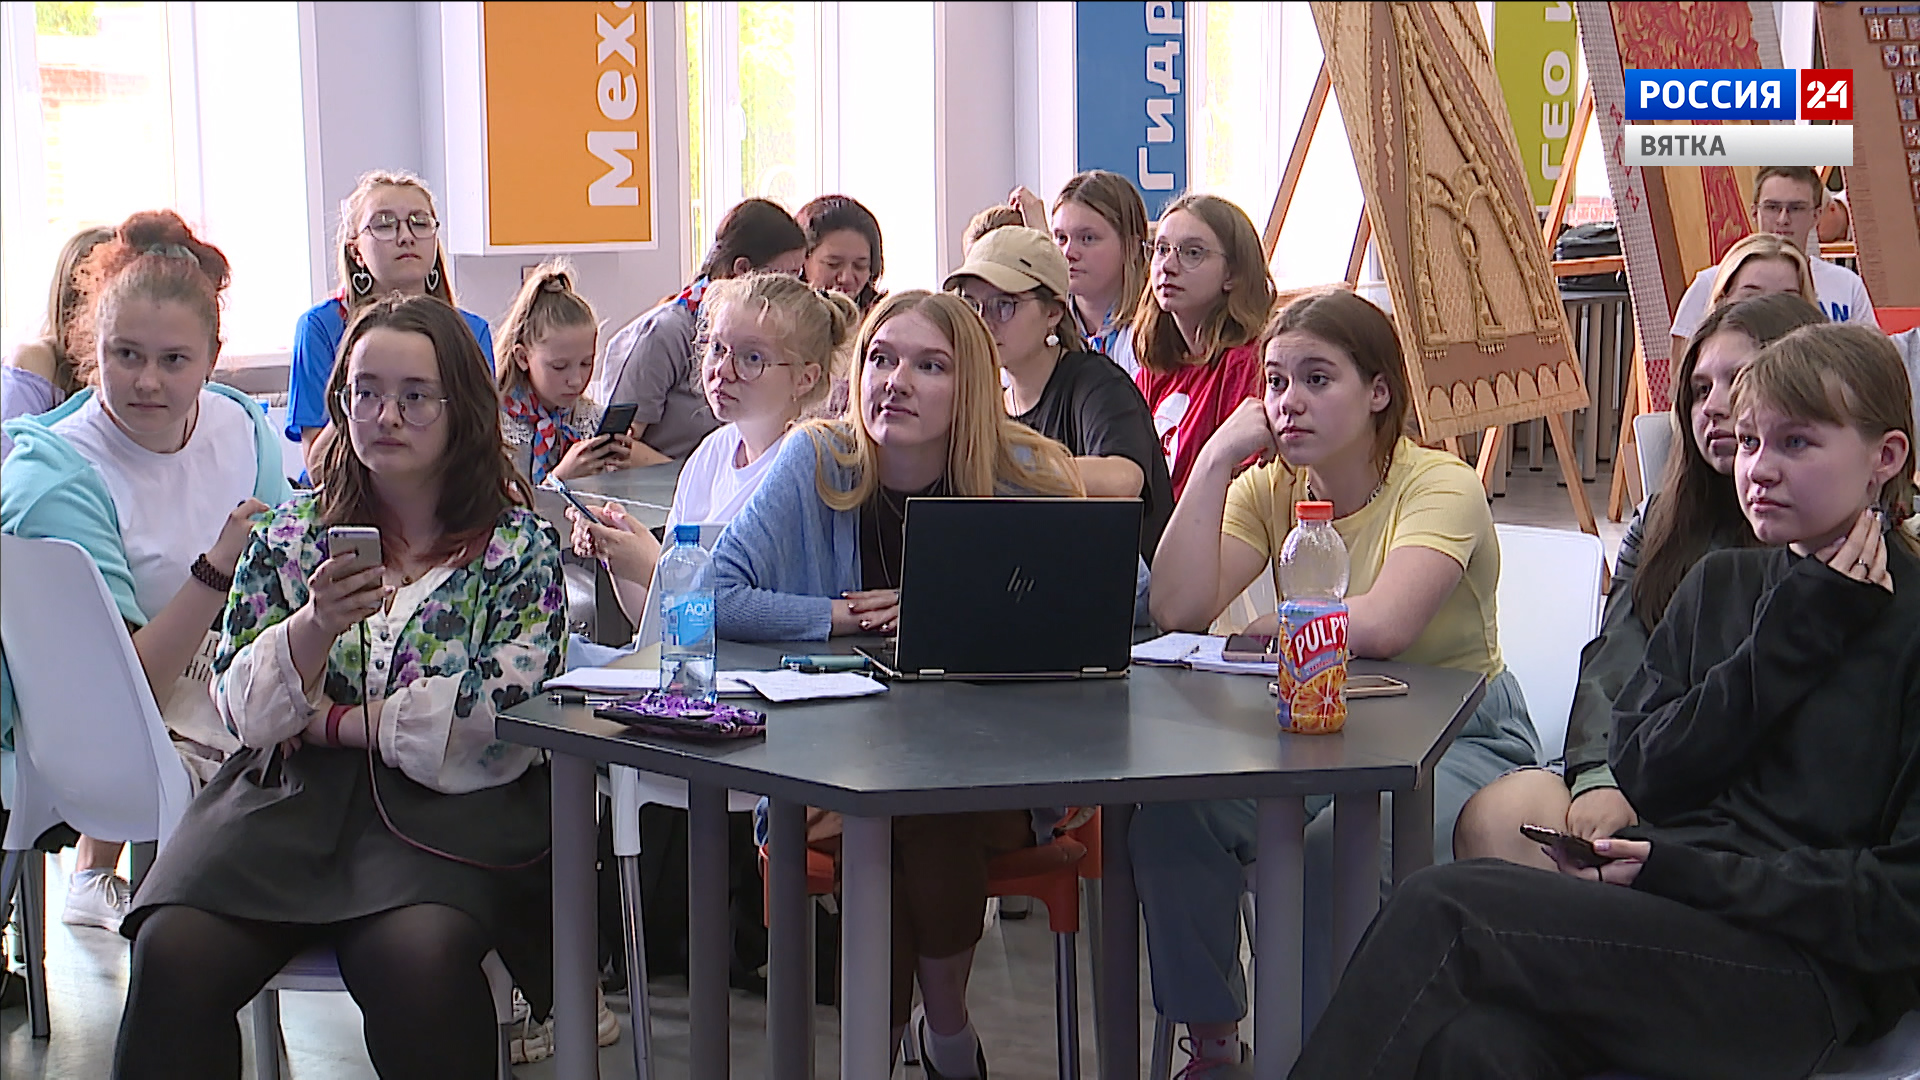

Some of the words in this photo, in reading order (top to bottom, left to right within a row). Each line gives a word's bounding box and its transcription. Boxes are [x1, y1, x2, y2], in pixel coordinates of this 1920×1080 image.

[586, 1, 640, 206] Мех
[1138, 1, 1184, 190] Гидр
[1541, 50, 1572, 180] ГЕО
[1006, 565, 1036, 604] hp
[1294, 614, 1348, 664] PULPY
